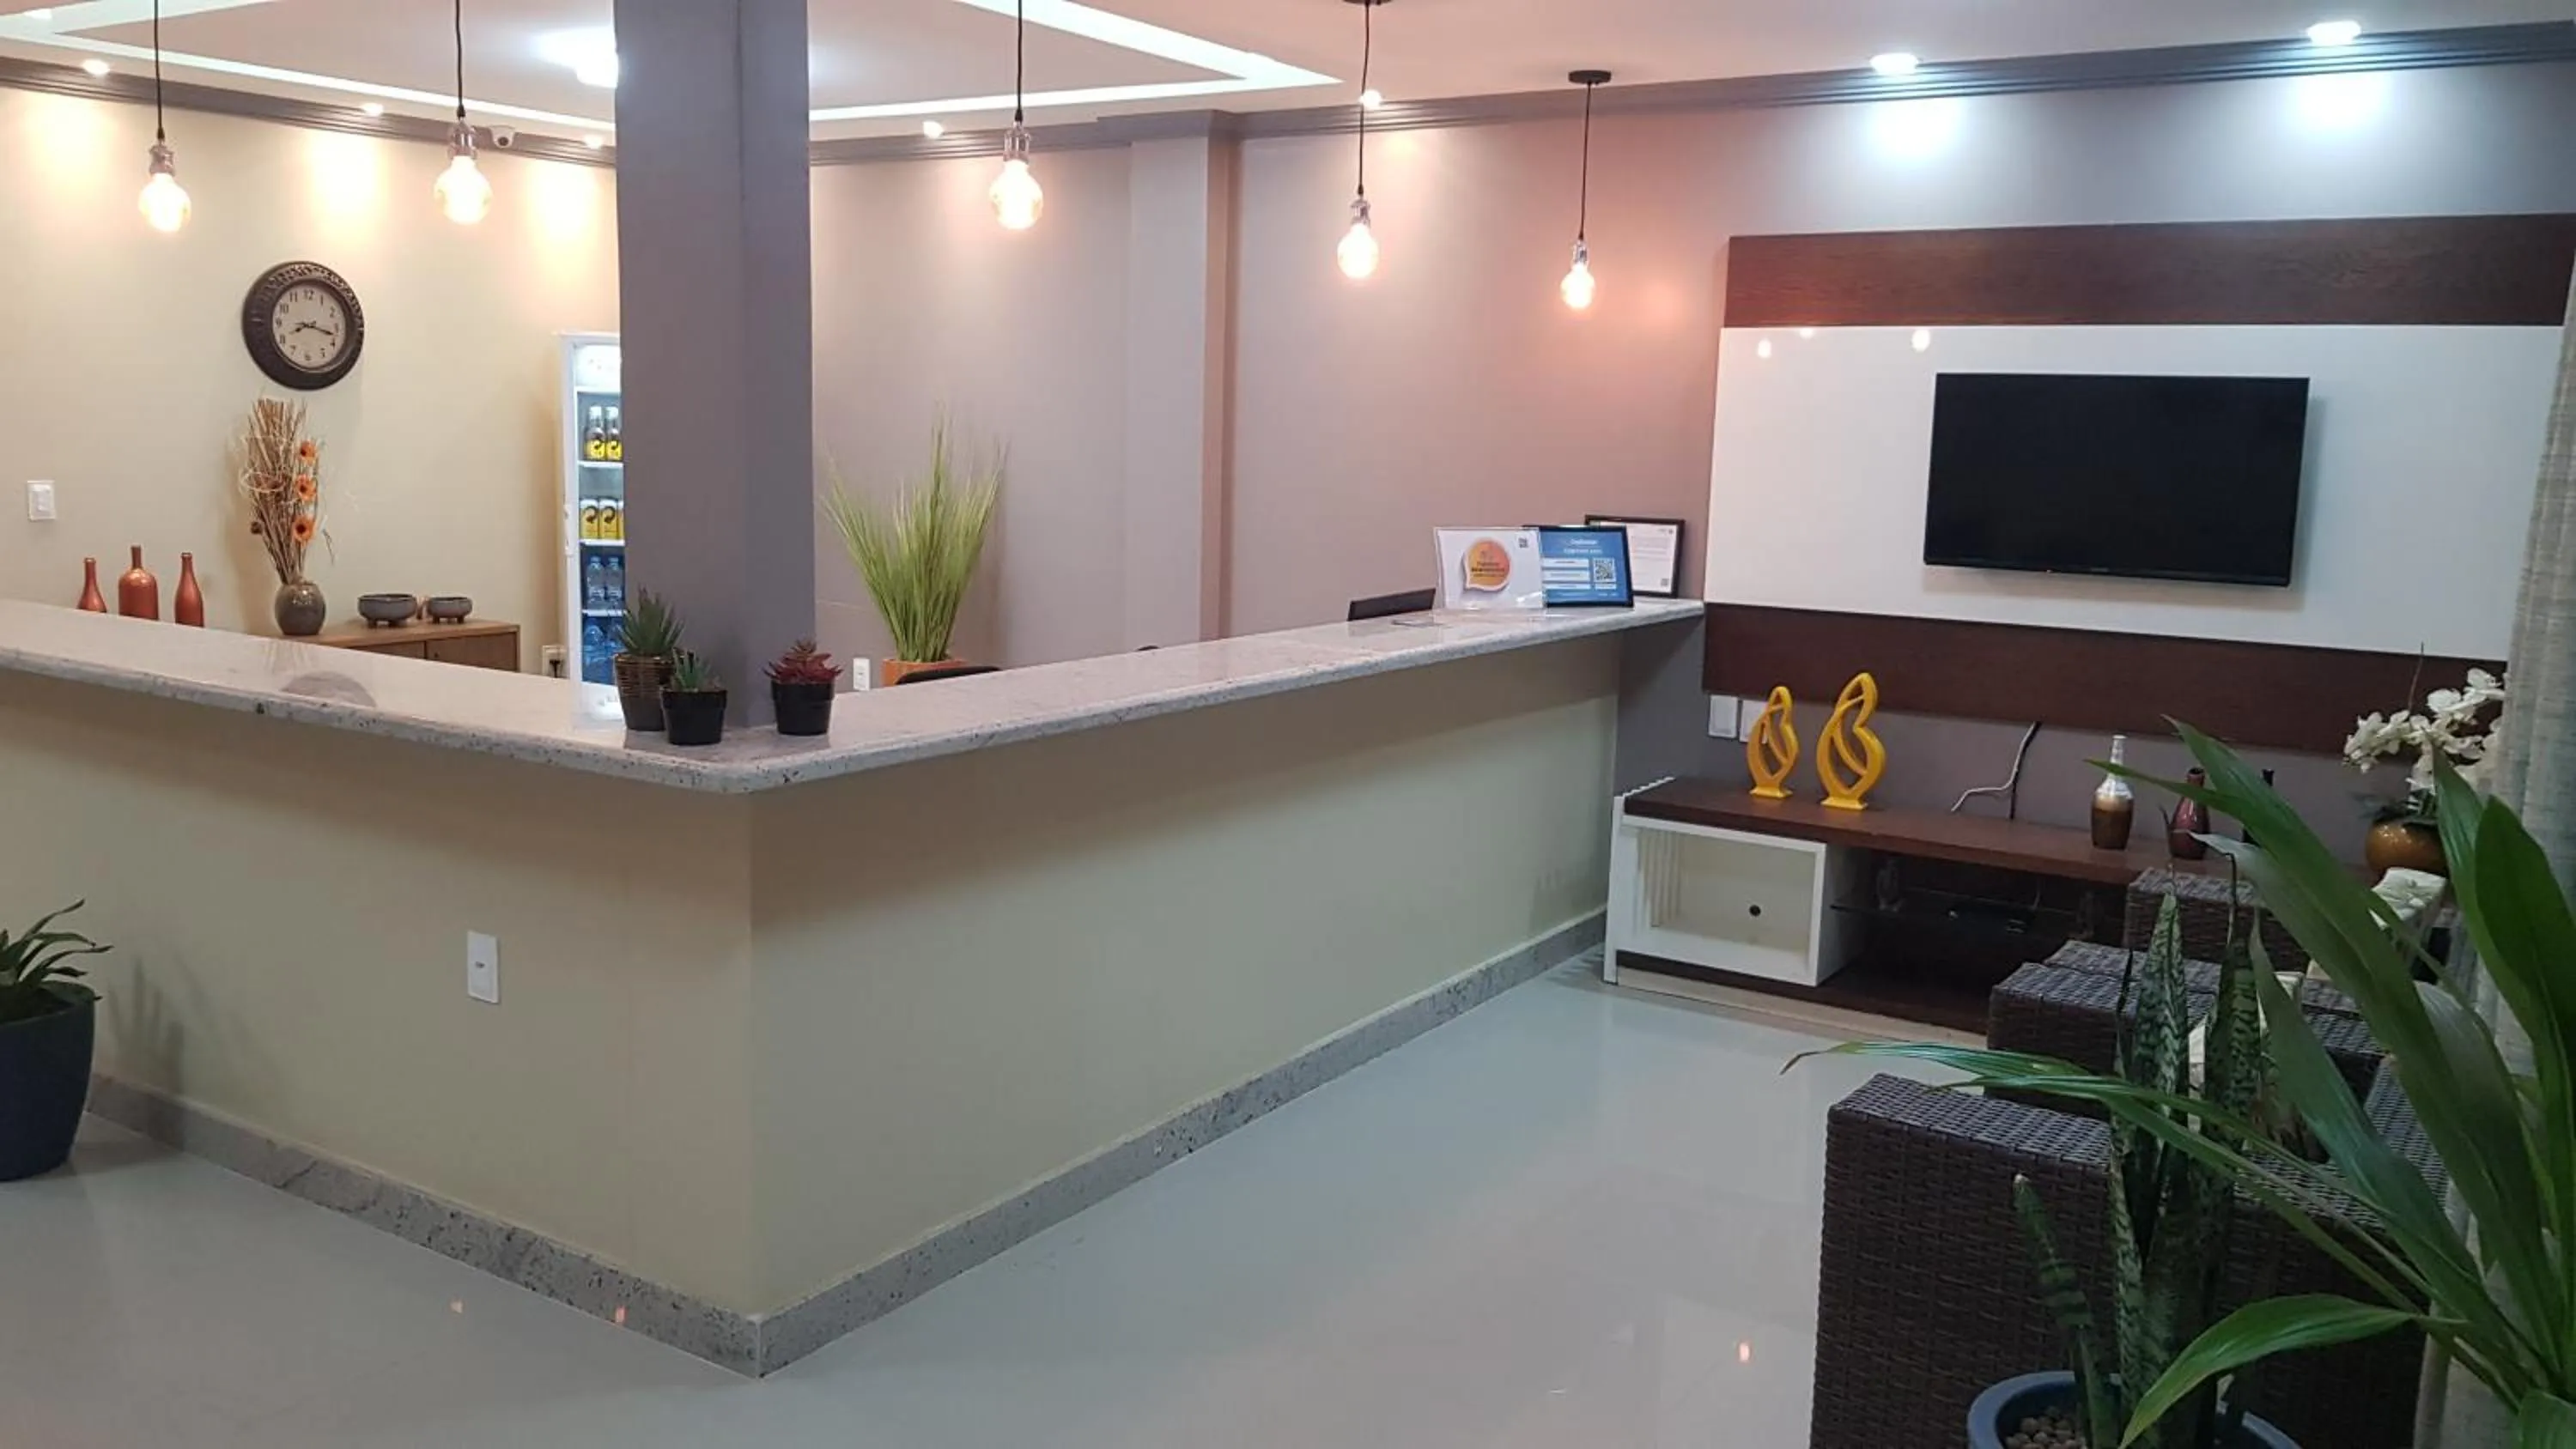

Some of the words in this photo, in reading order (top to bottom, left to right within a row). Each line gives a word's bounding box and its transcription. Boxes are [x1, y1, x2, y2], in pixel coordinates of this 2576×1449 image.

[289, 292, 298, 302] 11
[303, 289, 315, 301] 12
[279, 303, 289, 314] 10
